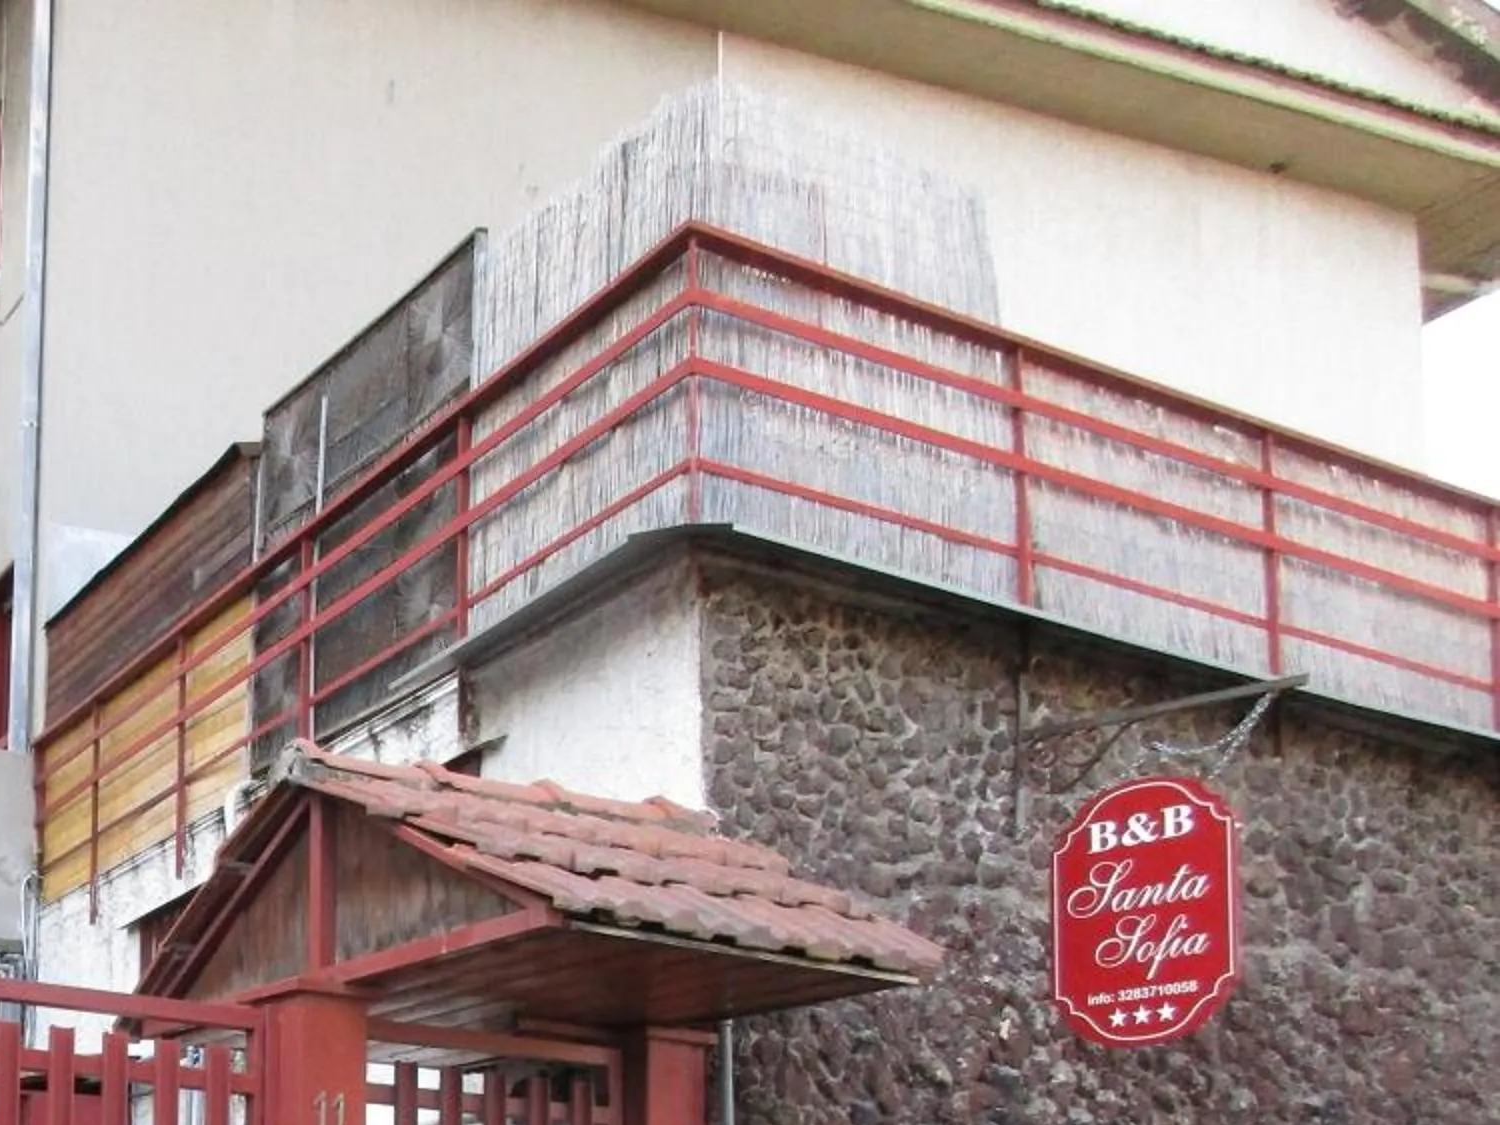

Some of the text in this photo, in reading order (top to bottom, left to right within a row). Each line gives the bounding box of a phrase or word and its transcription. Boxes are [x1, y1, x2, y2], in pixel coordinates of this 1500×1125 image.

[1087, 804, 1195, 854] B&B
[1067, 859, 1211, 918] Santa
[1095, 913, 1211, 980] Sofia
